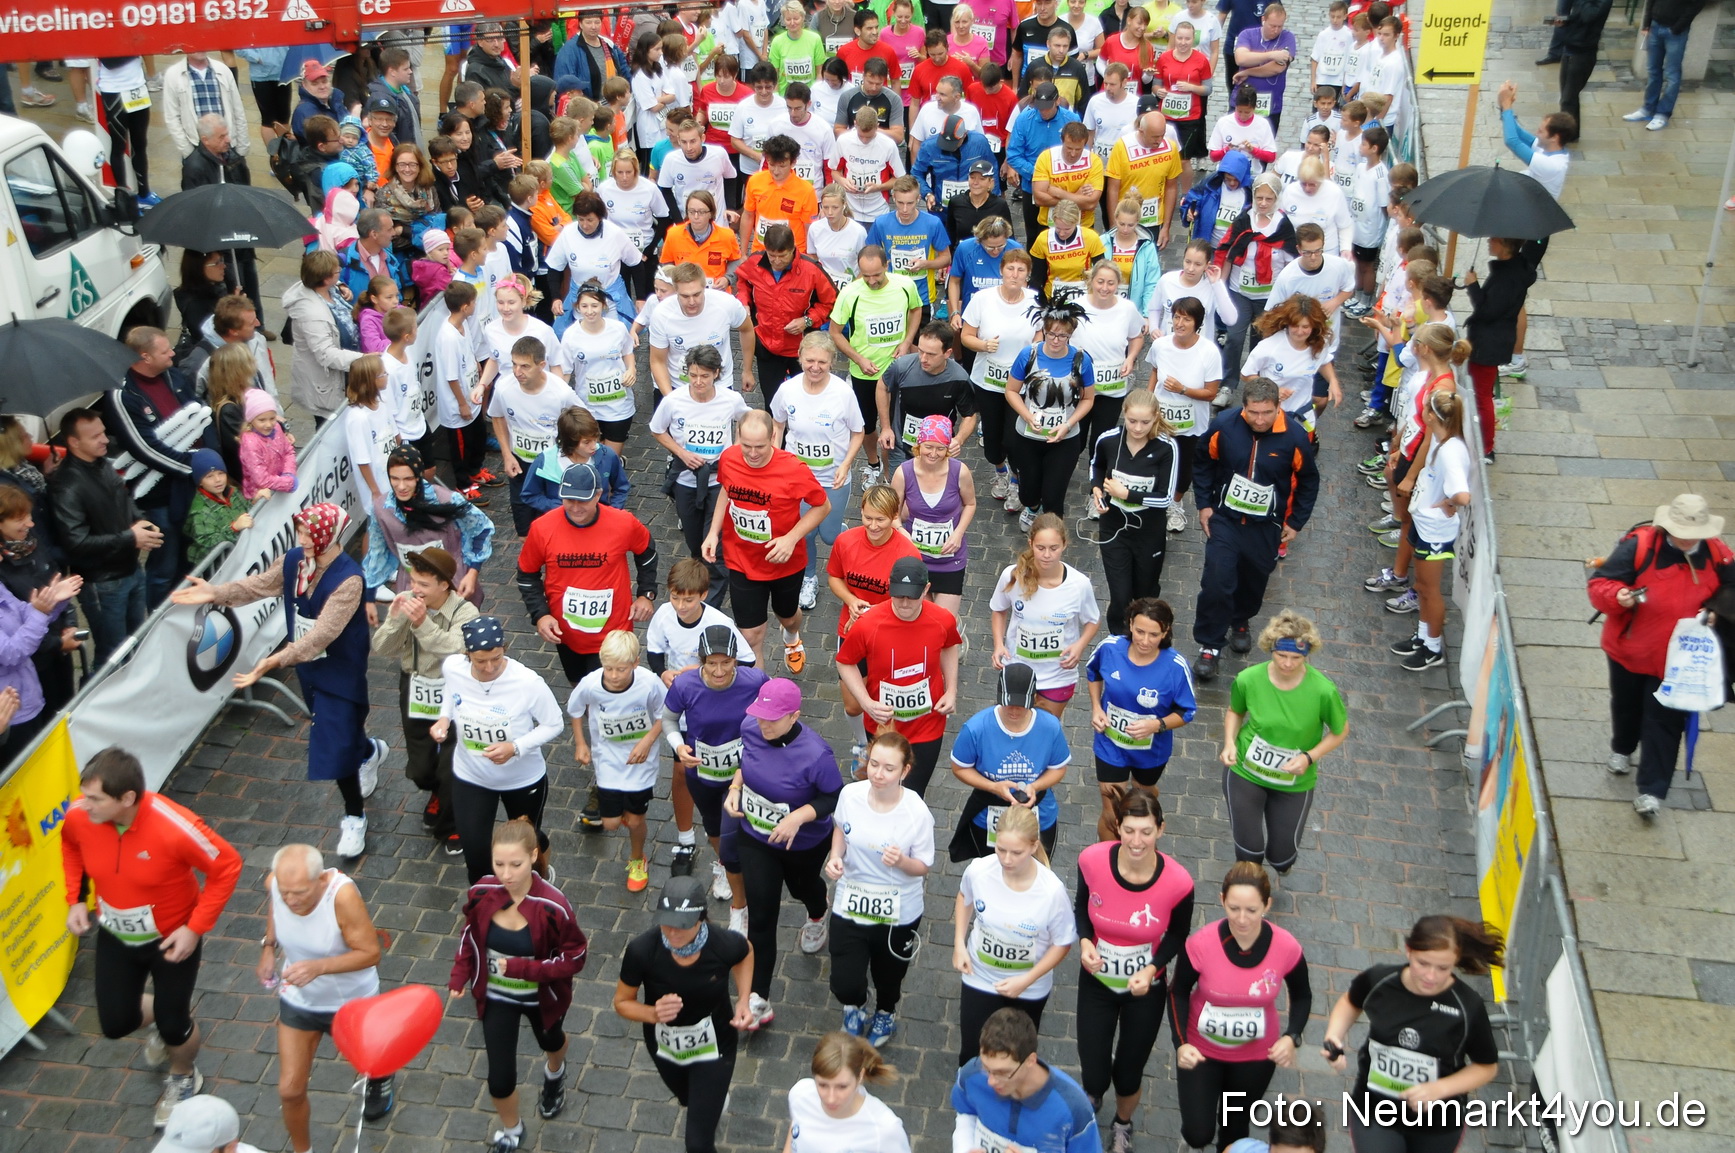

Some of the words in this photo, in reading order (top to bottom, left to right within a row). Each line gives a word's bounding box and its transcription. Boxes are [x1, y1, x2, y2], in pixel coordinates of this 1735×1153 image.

[121, 4, 196, 28] 09181
[203, 0, 269, 21] 6352
[1425, 13, 1487, 34] Jugend-
[1439, 31, 1469, 47] lauf
[787, 64, 811, 75] 5002
[1164, 100, 1188, 111] 5063
[1130, 161, 1150, 170] MAX
[1217, 208, 1238, 222] 176
[869, 319, 902, 337] 5097
[988, 366, 1010, 382] 504
[588, 378, 621, 396] 5078
[596, 394, 618, 402] Ramona
[516, 437, 550, 453] 5076
[688, 430, 725, 446] 2342
[695, 447, 716, 455] Andrea
[797, 442, 832, 459] 5159
[1232, 487, 1270, 506] 5132
[732, 514, 767, 533] 5014
[915, 529, 951, 546] 5170
[567, 598, 608, 617] 5184
[1019, 634, 1060, 651] 5145
[1029, 651, 1048, 660] Elena
[414, 686, 443, 706] 515
[880, 689, 897, 699] PARTL
[898, 687, 922, 698] Neumarkt
[884, 691, 927, 708] 5066
[462, 724, 507, 744] 5119
[603, 718, 648, 736] 5143
[620, 733, 635, 741] Max
[701, 750, 741, 769] 5141
[746, 797, 786, 825] 5122
[846, 885, 864, 895] PARTL
[864, 888, 891, 898] Neumarkt
[2, 880, 56, 942] Außenplatten
[847, 894, 894, 916] 5083
[5, 912, 43, 957] Palisaden
[11, 940, 37, 972] Stufen
[981, 937, 1031, 963] 5082
[994, 960, 1013, 970] Anja
[1099, 954, 1148, 977] 5168
[1221, 1009, 1253, 1019] Neumarkt
[1205, 1018, 1259, 1040] 5169
[659, 1029, 710, 1052] 5134
[1376, 1053, 1430, 1085] 5025
